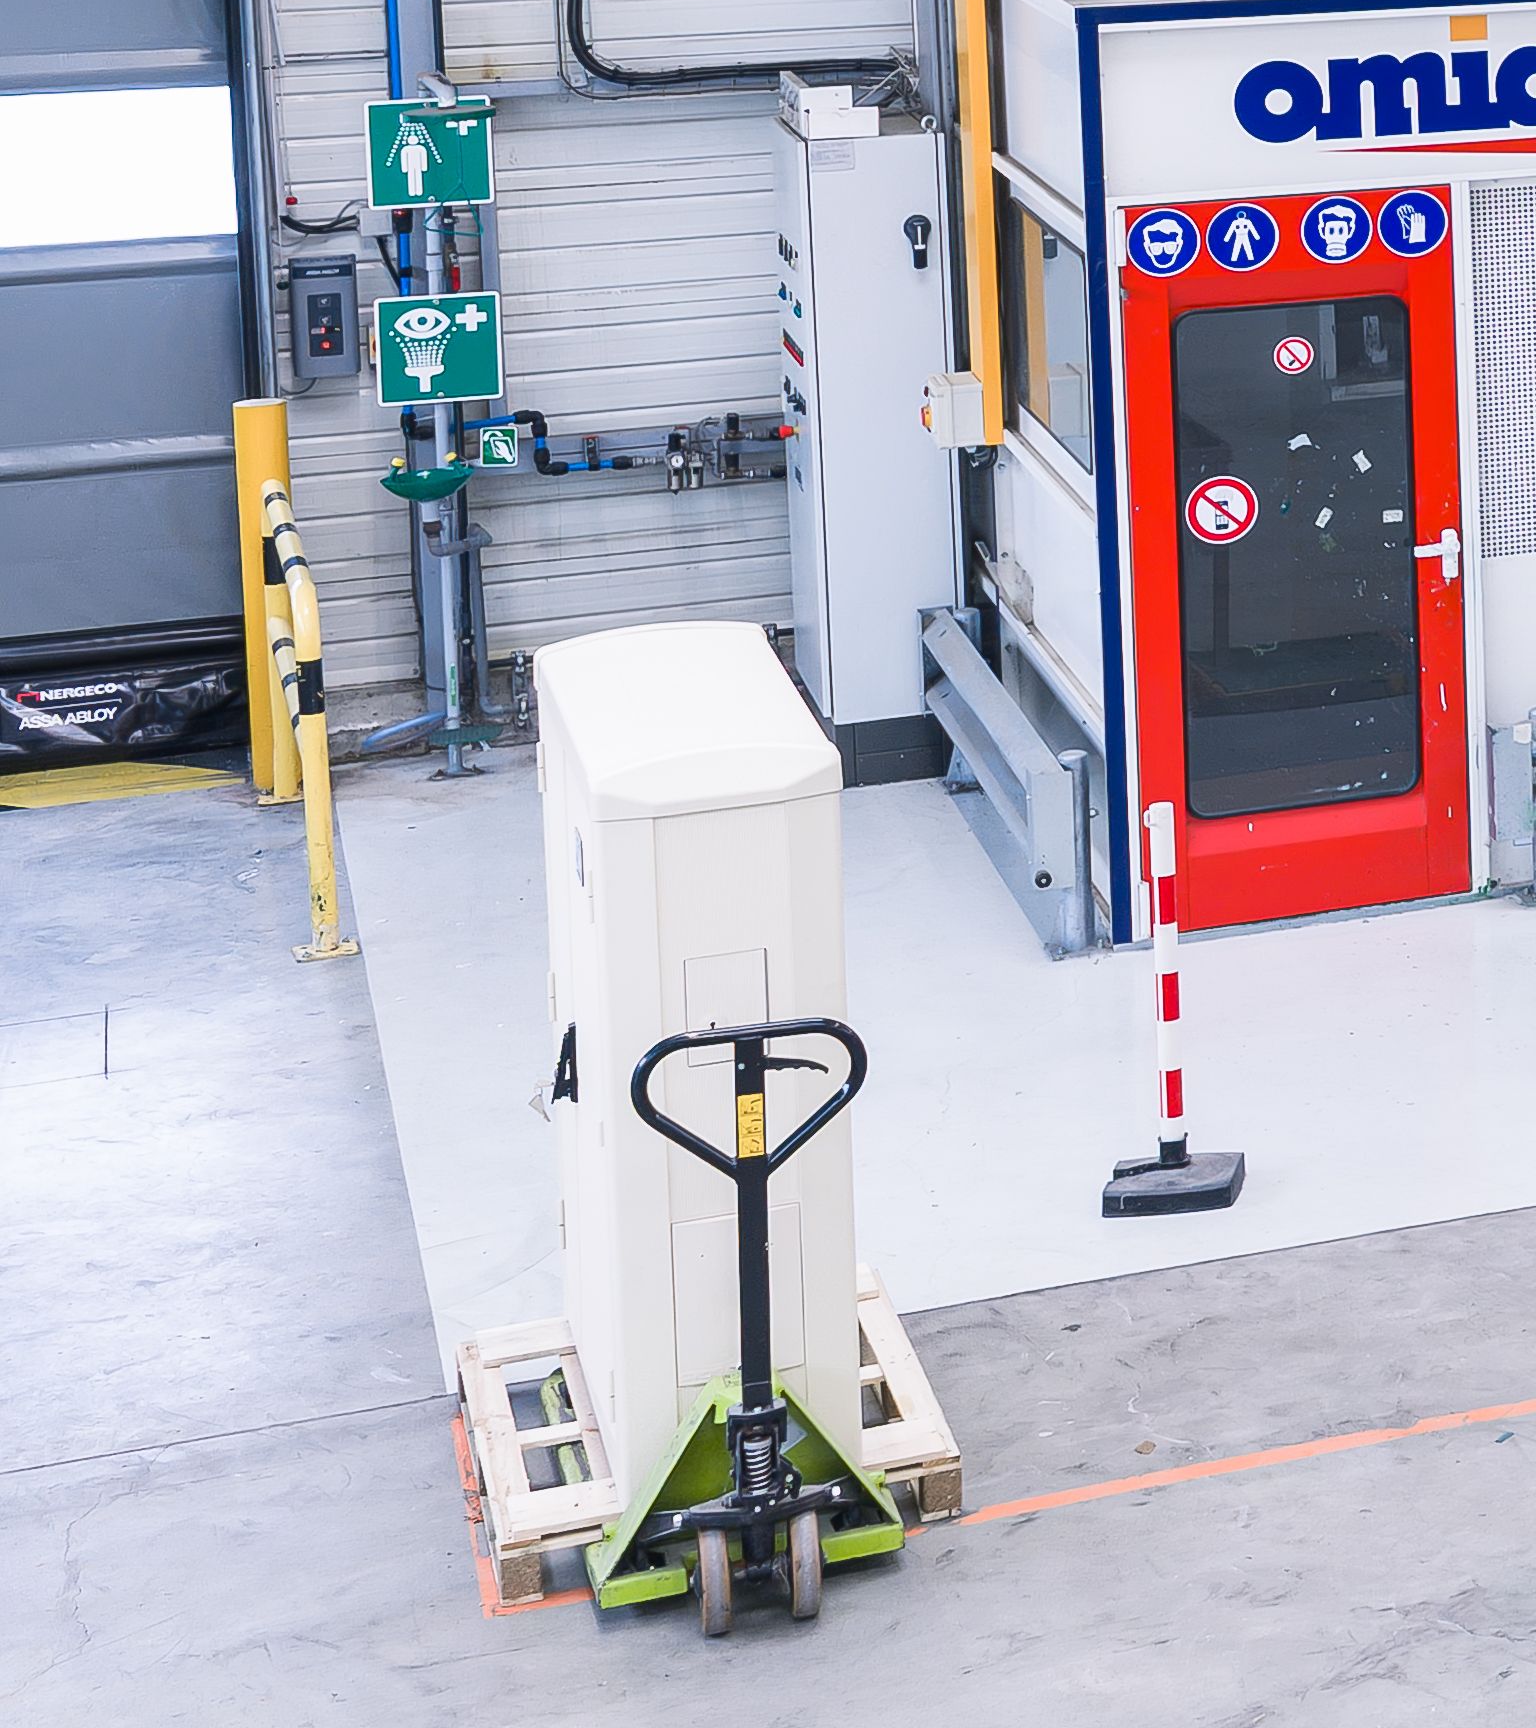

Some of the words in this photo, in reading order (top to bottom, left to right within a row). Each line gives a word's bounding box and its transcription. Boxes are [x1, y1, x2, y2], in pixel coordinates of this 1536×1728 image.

[39, 682, 118, 702] NERGECO
[18, 713, 64, 731] ASSA
[64, 706, 118, 726] ABLOY
